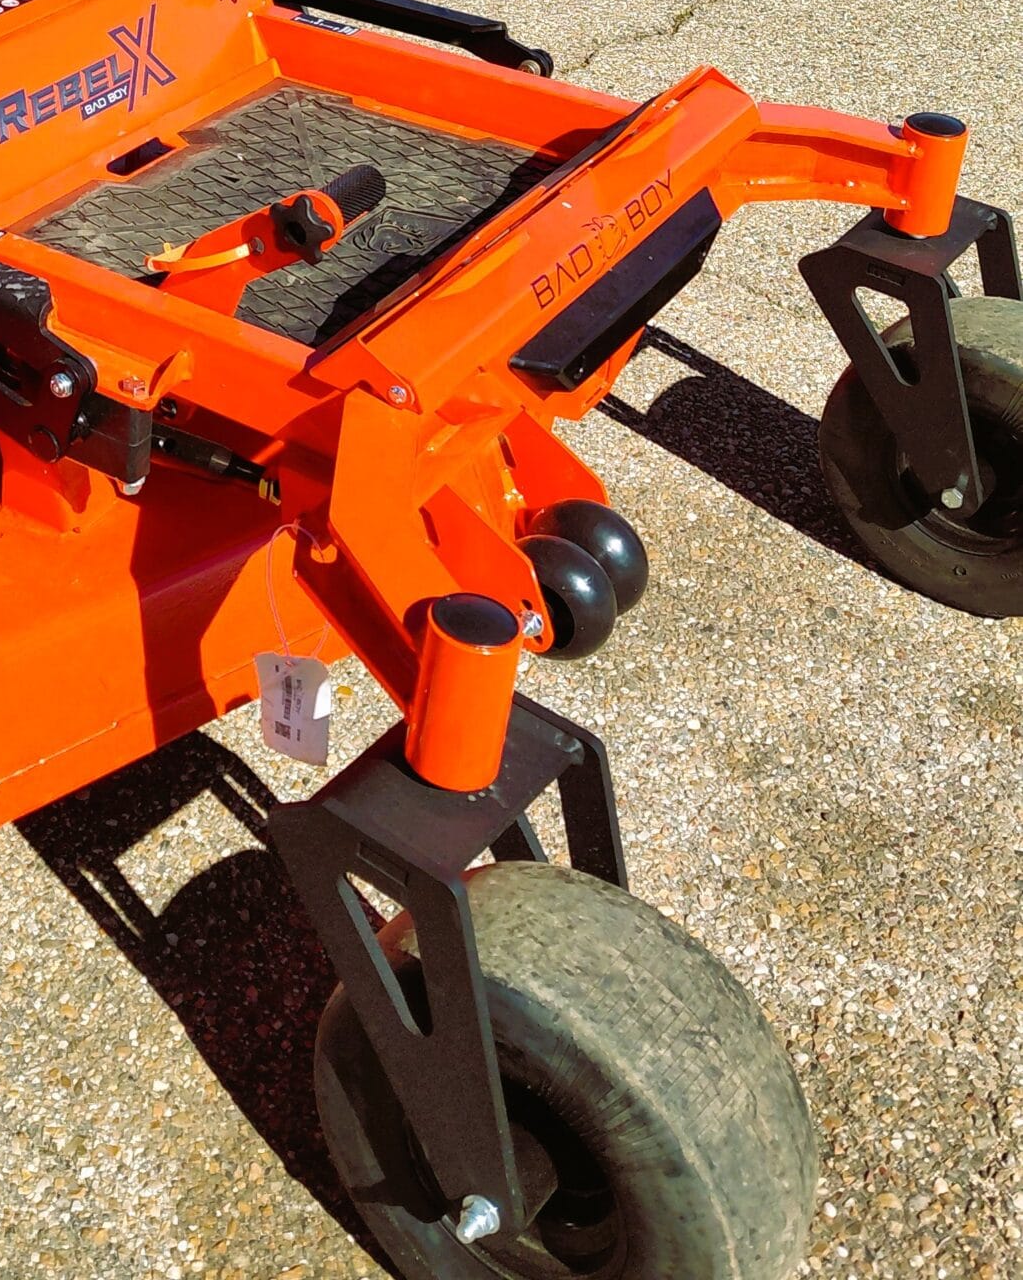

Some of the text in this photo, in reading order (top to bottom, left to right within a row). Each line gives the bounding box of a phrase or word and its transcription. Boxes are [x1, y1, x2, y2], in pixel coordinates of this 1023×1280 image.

[84, 85, 128, 116] BAD BOY
[530, 169, 673, 310] BAD BOY
